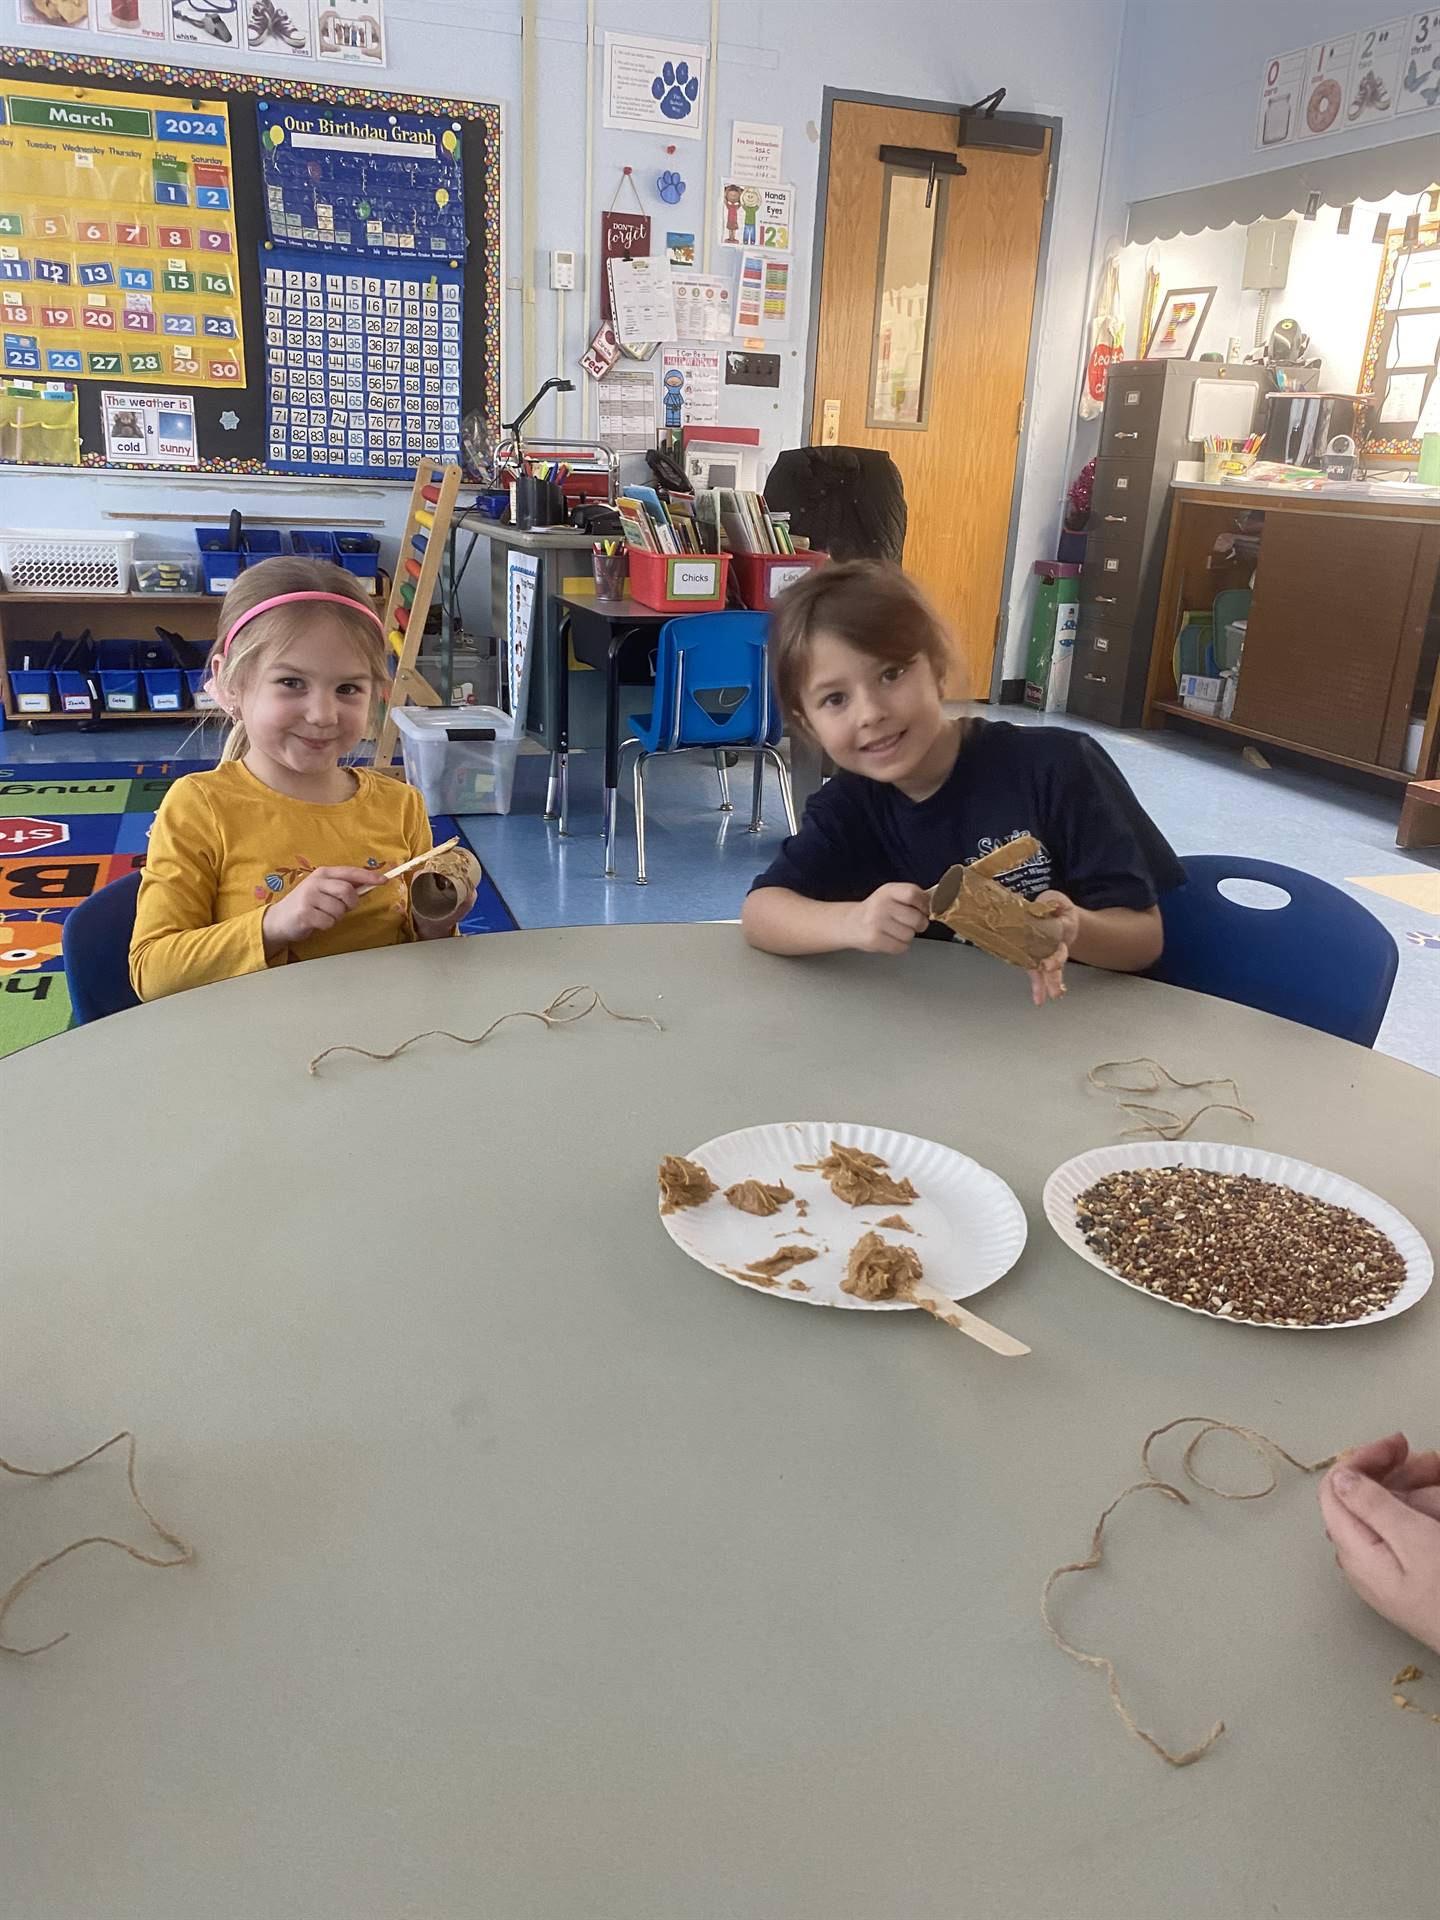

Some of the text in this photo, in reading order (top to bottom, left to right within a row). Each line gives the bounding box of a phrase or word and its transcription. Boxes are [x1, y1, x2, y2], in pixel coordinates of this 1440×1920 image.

[1411, 44, 1432, 56] three
[49, 107, 114, 128] March
[165, 119, 218, 136] 2024
[284, 116, 436, 144] Our Birthday Graph
[26, 140, 57, 151] Tuesday
[62, 143, 105, 156] Wednesday
[108, 147, 142, 160] Thursday
[154, 152, 177, 161] Friday
[191, 154, 223, 165] Saturday
[167, 187, 220, 204] 1 2
[764, 192, 786, 200] Hands
[766, 206, 782, 215] Eyes
[0, 218, 222, 248] 4 5 6 7 8 9
[608, 223, 646, 250] forget
[3, 263, 226, 291] 11 12 13 14 15 16
[273, 273, 457, 299] 1 2 3 4 5 6 7 8 10
[271, 292, 457, 317] 11 12 13 14 15 16 17 18 19 20
[5, 307, 232, 334] 18 19 20 21 22 23
[269, 312, 459, 339] 21 22 23 24 25 26 27 28 29 30
[1160, 302, 1196, 343] P
[270, 332, 456, 356] 31 32 33 34 35 36 37 38 39 40
[10, 352, 237, 378] 25 26 27 28 29 30
[271, 352, 457, 374] 41 42 43 44 45 46 47 48 49 50
[584, 356, 603, 374] red
[107, 396, 188, 409] The weather is
[146, 425, 154, 435] &
[117, 442, 140, 452] cold
[160, 444, 191, 456] sunny
[682, 573, 708, 583] Chicks
[0, 784, 115, 795] mug
